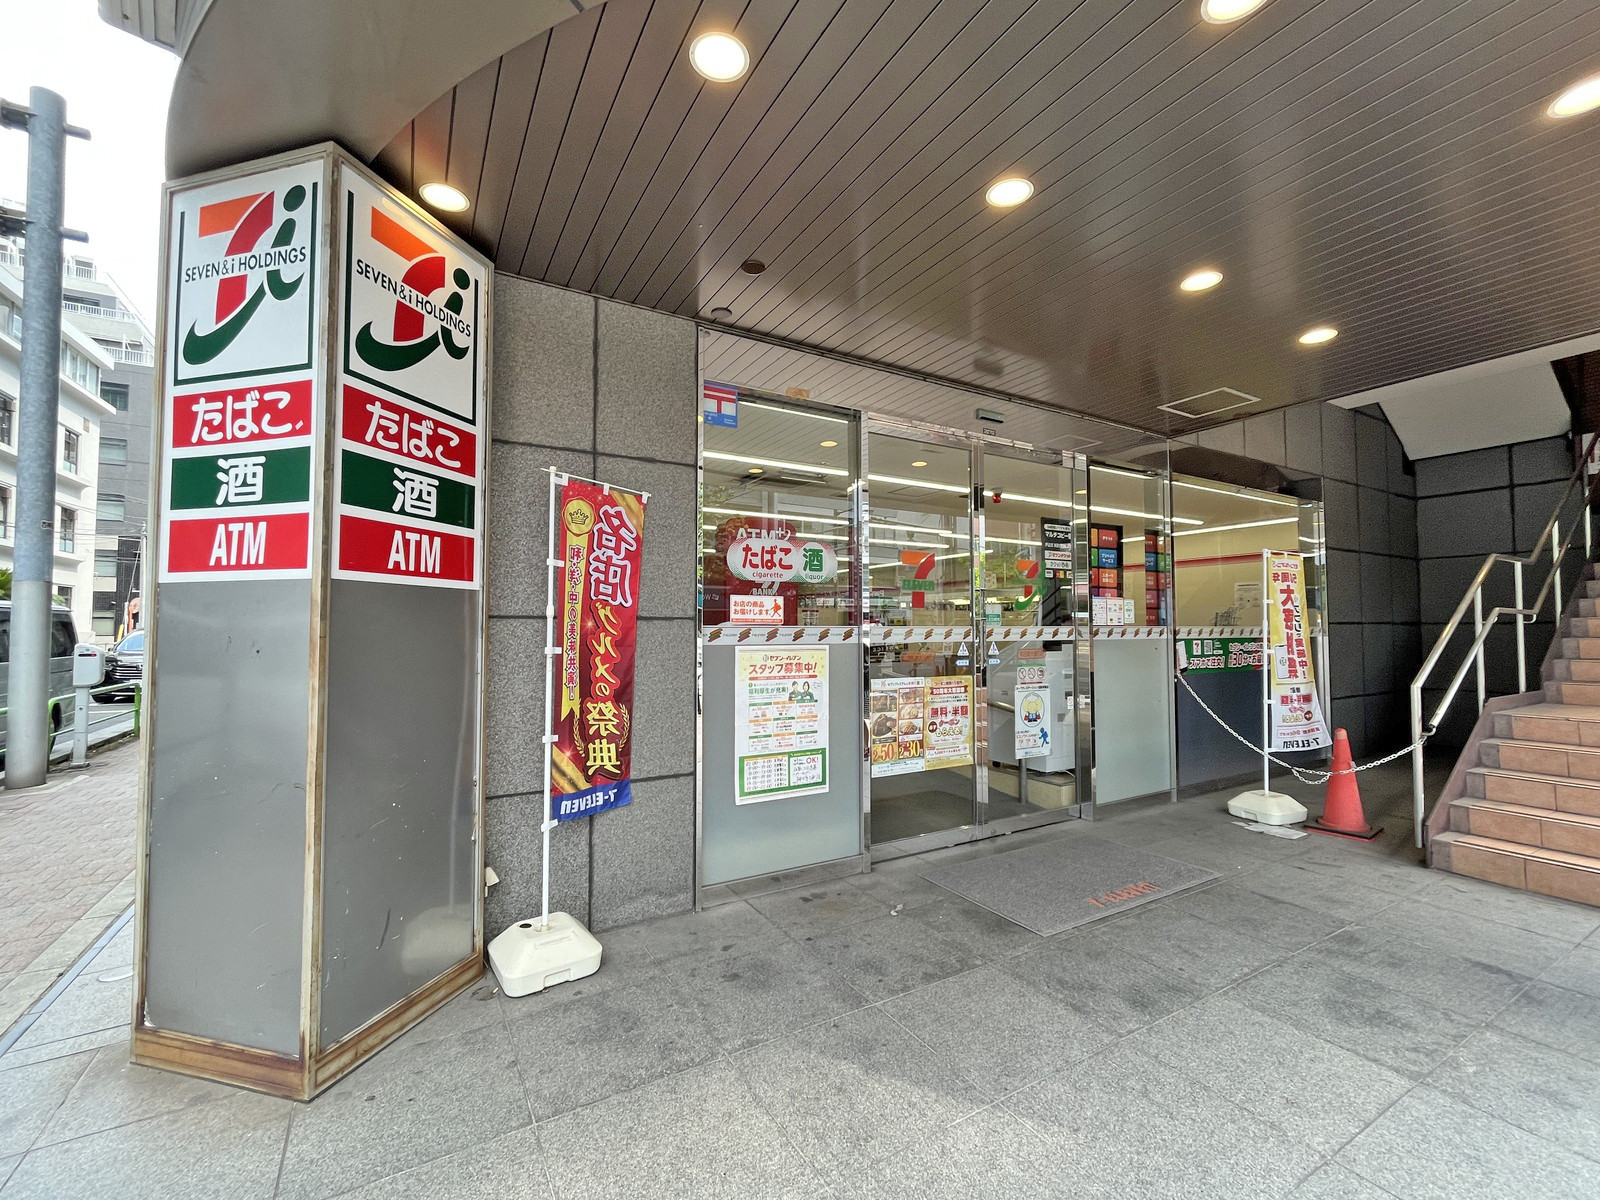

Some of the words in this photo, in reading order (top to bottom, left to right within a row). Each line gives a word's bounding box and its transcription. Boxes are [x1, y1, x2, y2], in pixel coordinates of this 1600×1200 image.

[238, 246, 306, 271] HOLDINGS
[415, 295, 471, 337] HOLDINGS
[191, 390, 303, 444] たばこ
[365, 401, 461, 468] たばこ
[216, 456, 266, 506] 酒
[392, 467, 439, 518] 酒
[209, 521, 267, 566] ATM
[387, 530, 440, 574] ATM
[742, 544, 793, 570] たばこ
[802, 547, 824, 572] 酒
[752, 571, 784, 580] cigarette
[804, 573, 824, 581] liquor
[733, 600, 765, 608] お店の商品
[749, 662, 817, 675] スタッフ募集中!
[806, 756, 819, 764] OK!
